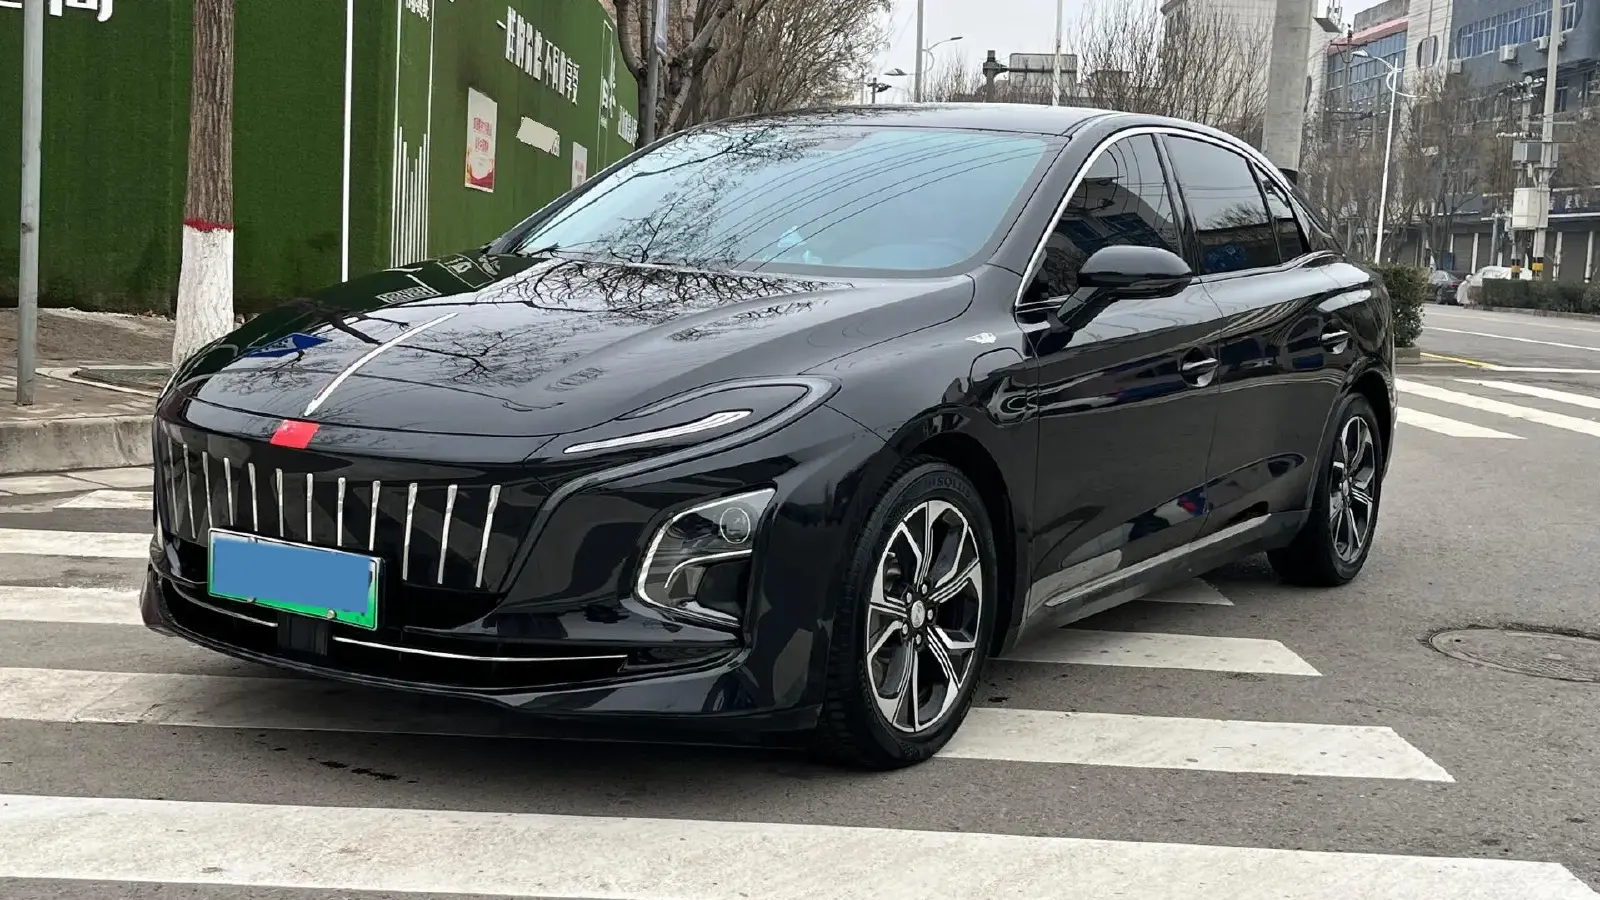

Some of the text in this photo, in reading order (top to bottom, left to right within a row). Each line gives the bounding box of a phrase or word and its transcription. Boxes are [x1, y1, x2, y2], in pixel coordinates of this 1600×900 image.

[544, 39, 580, 105] 不同的享受
